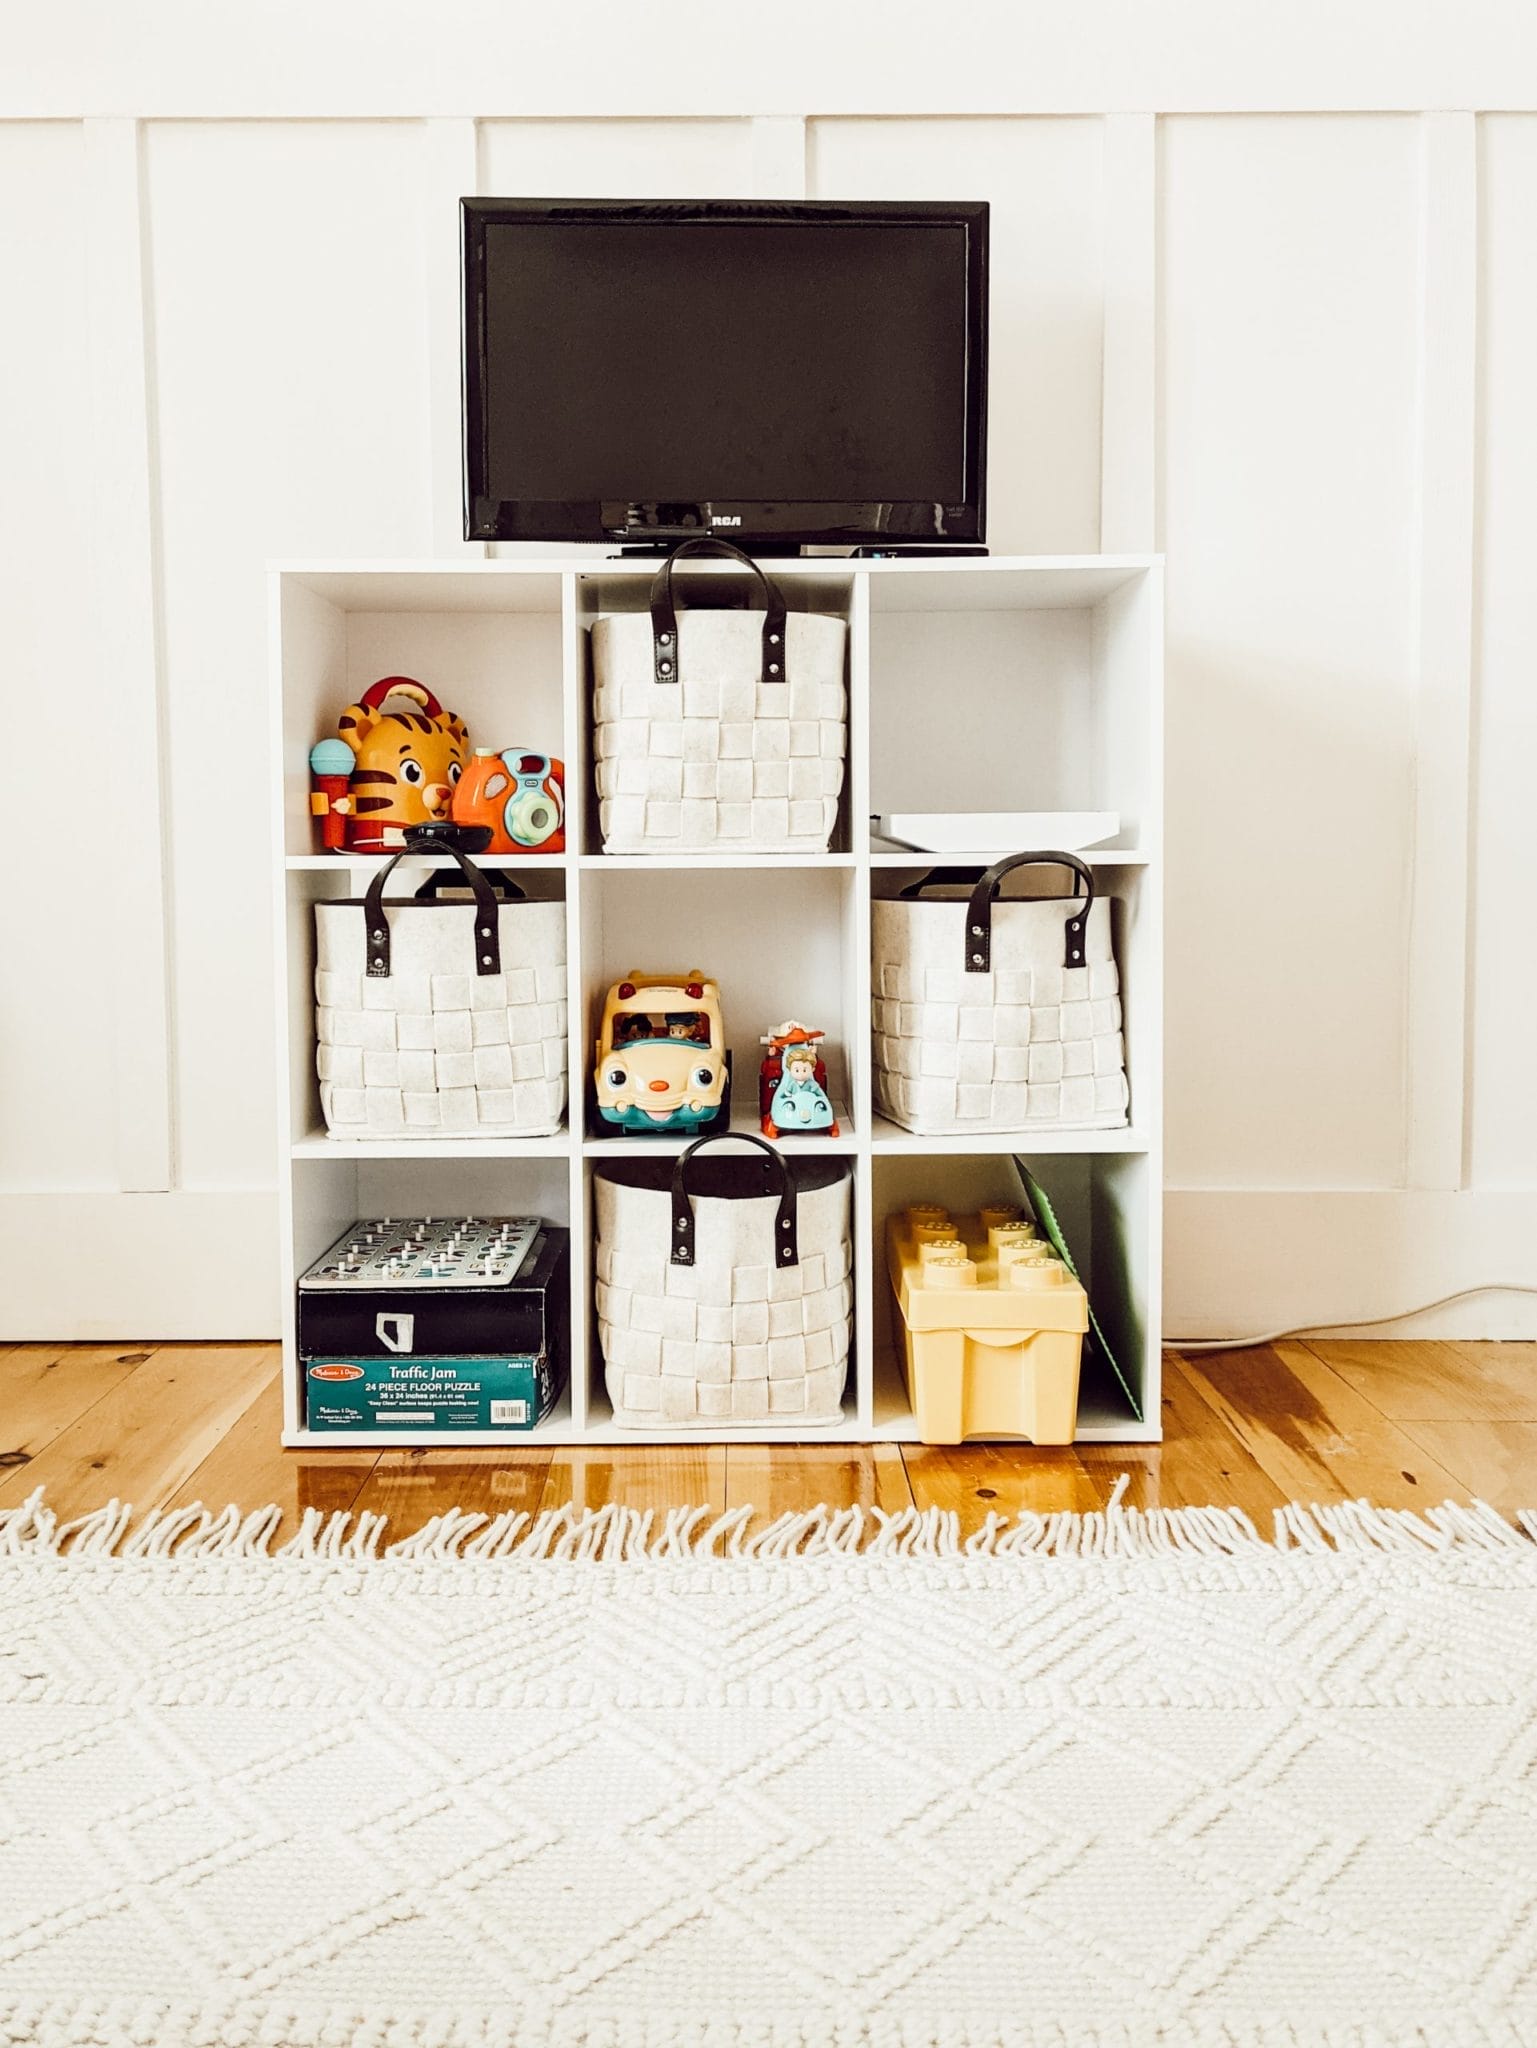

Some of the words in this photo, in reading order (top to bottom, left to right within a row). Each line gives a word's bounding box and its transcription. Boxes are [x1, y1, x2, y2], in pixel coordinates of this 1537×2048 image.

[712, 516, 741, 526] RCA
[389, 1366, 428, 1378] Traffic
[431, 1366, 457, 1380] Jam
[365, 1383, 376, 1391] 24
[379, 1383, 407, 1391] PIECE
[410, 1383, 442, 1391] FLOOR
[445, 1382, 481, 1391] PUZZLE
